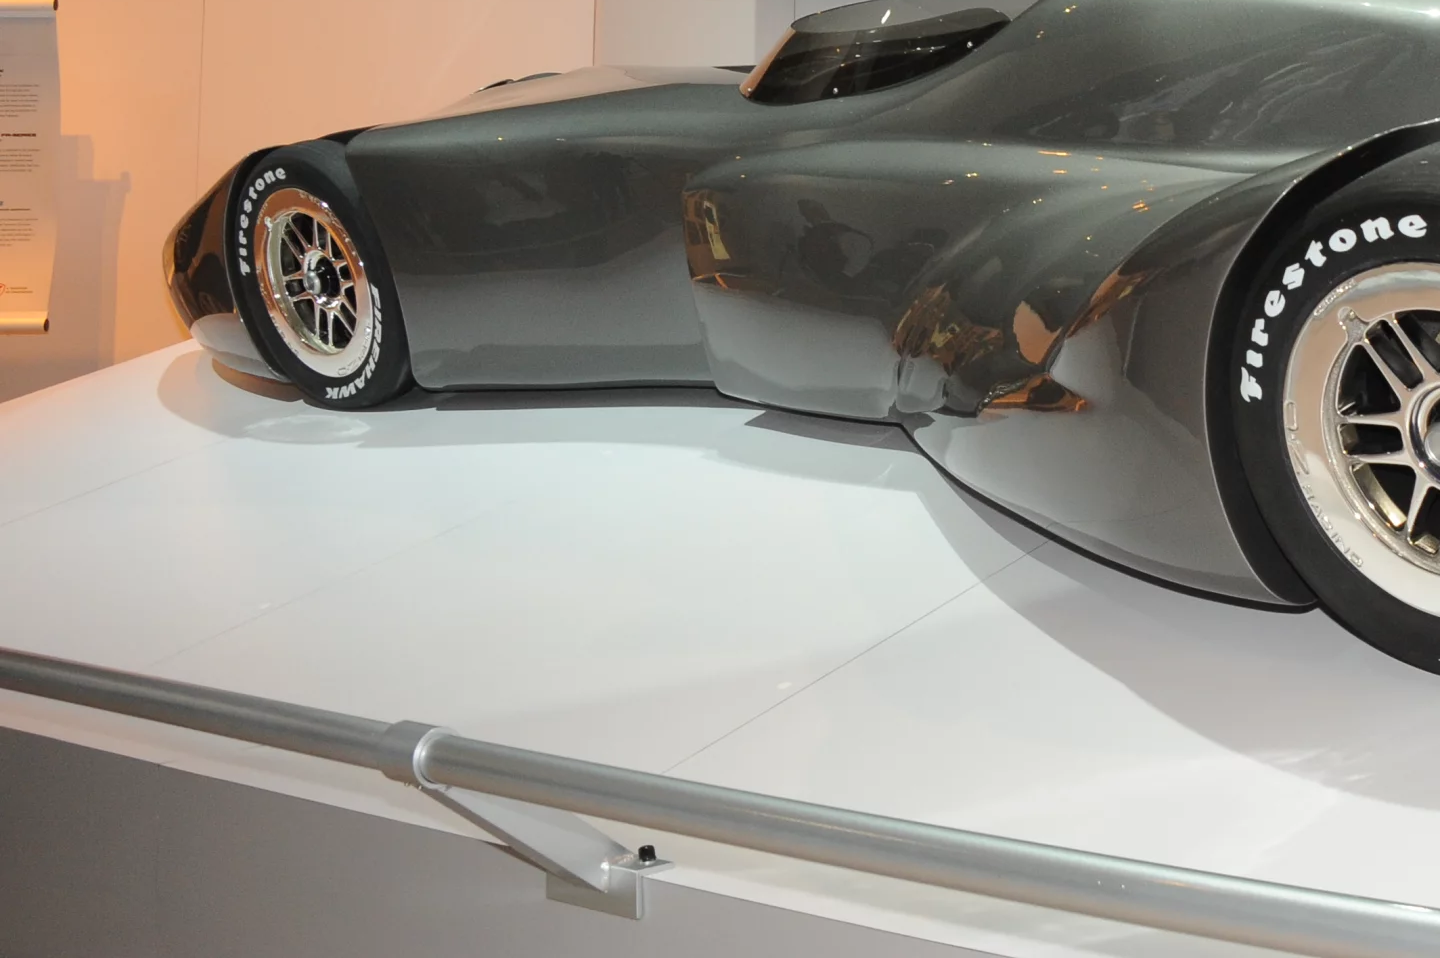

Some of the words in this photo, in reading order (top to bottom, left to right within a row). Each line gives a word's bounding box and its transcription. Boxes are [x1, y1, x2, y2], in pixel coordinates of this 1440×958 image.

[239, 166, 286, 276] Firestone
[325, 283, 382, 400] FIREHAWK
[1240, 213, 1428, 404] Firestone
